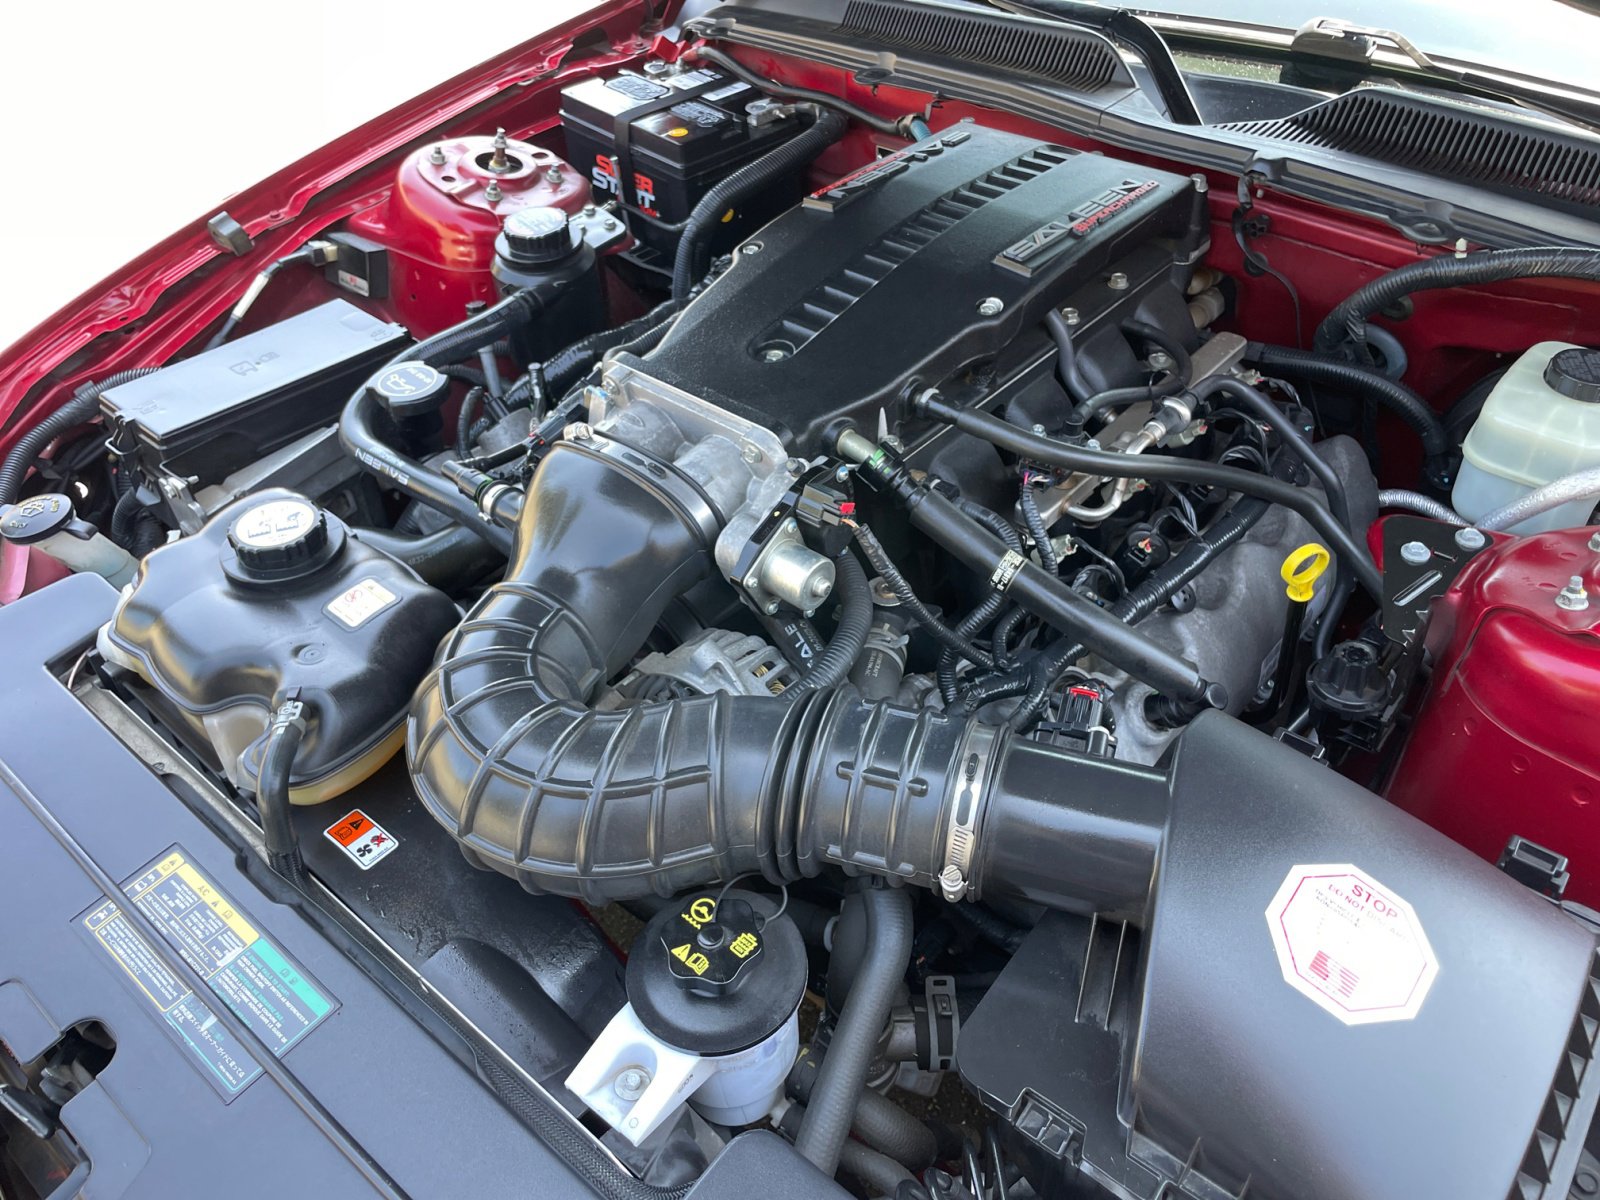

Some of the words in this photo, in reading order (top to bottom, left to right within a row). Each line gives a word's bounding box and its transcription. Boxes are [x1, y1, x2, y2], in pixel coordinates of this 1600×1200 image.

[592, 166, 656, 209] STT
[595, 153, 654, 196] SER
[1002, 178, 1145, 262] SALEEN
[1072, 179, 1160, 238] SUPERCHARGED
[354, 447, 410, 486] SALEEN
[1352, 885, 1398, 918] STOP
